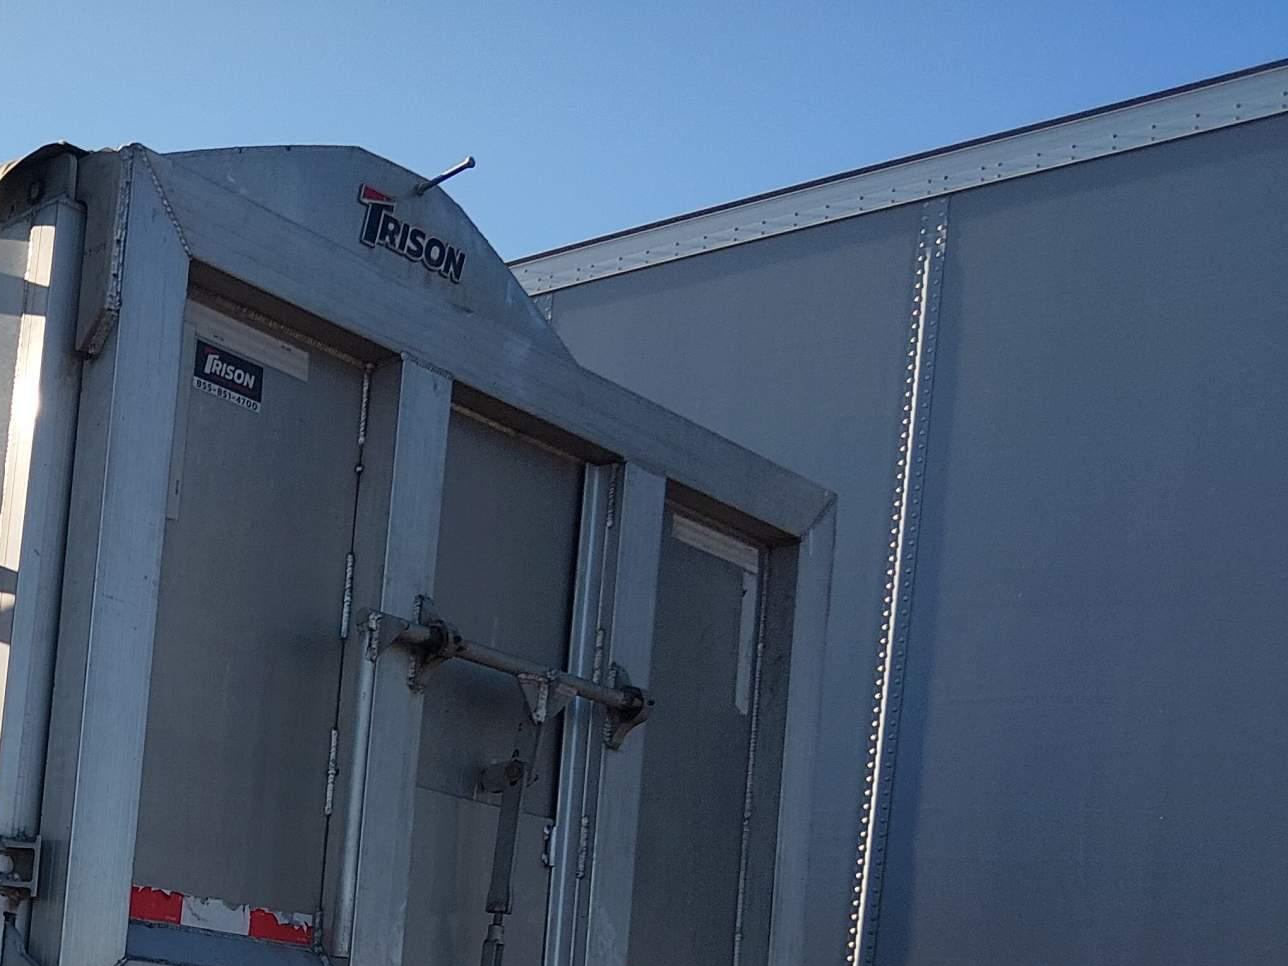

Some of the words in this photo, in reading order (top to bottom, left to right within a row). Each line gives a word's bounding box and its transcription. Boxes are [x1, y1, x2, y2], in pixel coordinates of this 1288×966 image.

[359, 184, 467, 284] TRISON
[203, 345, 256, 389] TRISON
[196, 379, 258, 411] 855-851-4700
